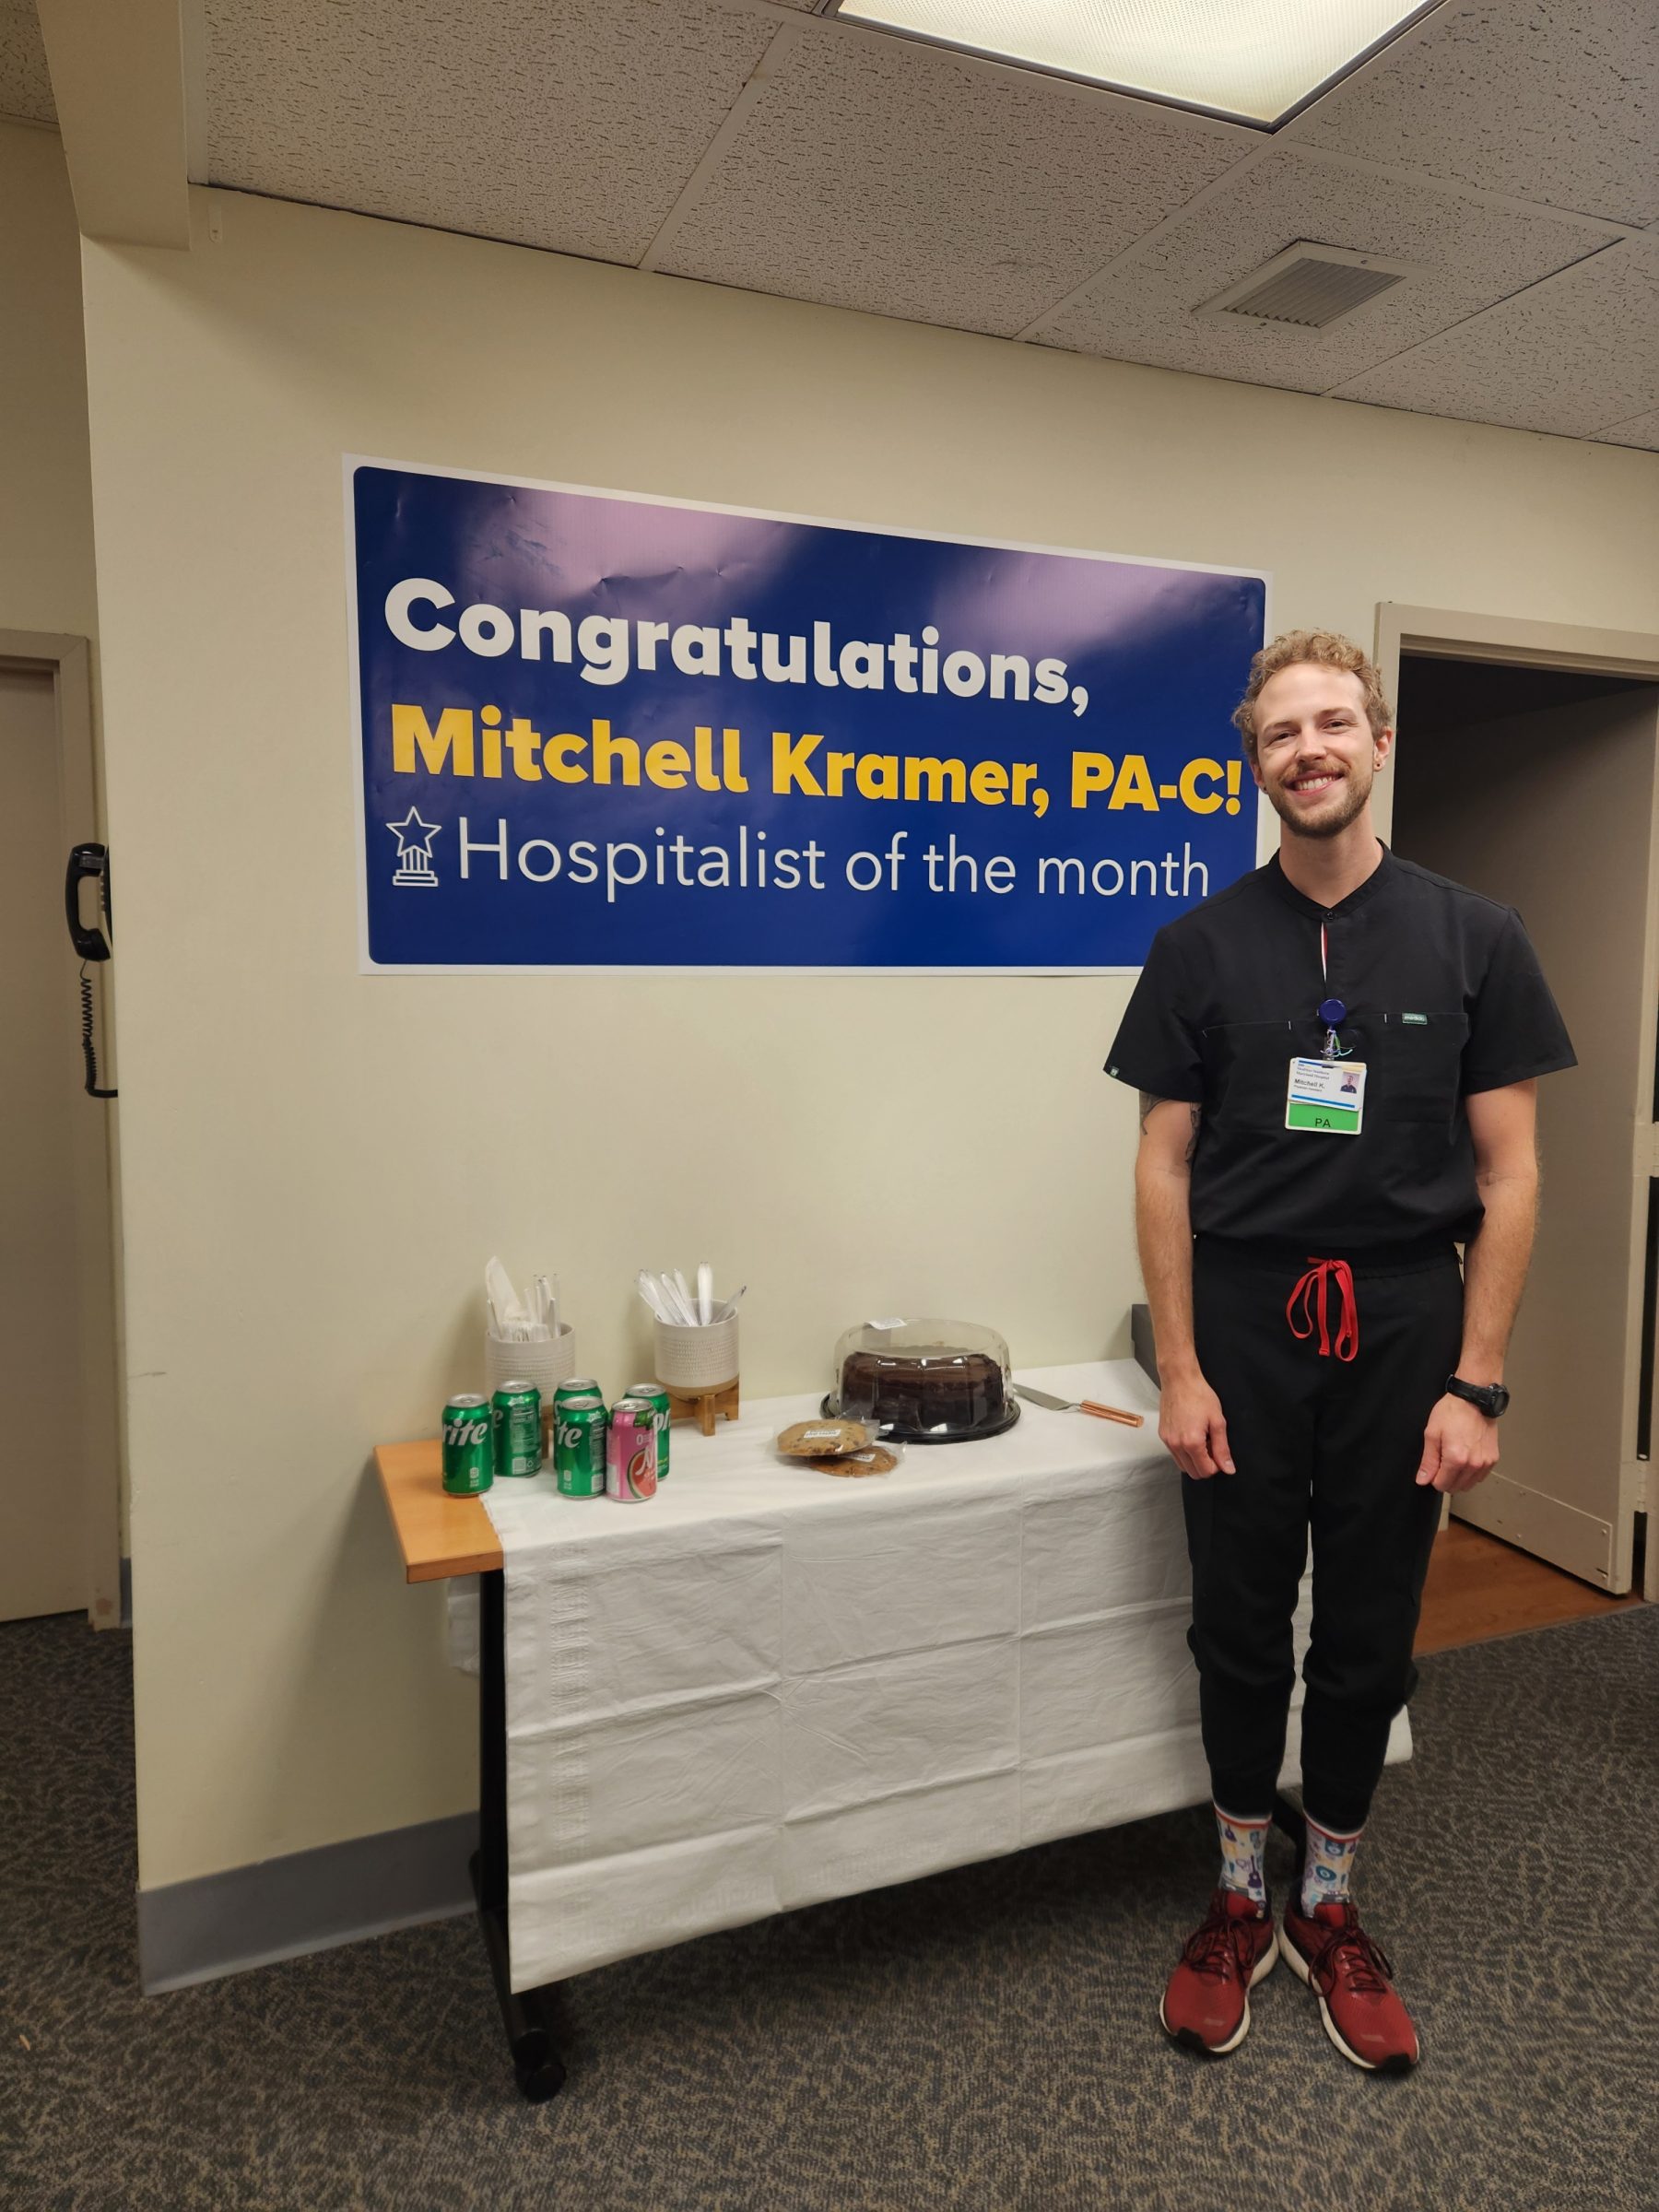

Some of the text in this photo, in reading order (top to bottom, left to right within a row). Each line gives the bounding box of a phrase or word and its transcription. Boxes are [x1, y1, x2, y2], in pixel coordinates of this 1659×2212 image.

[384, 578, 1089, 717] Congratulations,
[392, 704, 1242, 818] Mitchell Kramer, PA-C!
[459, 817, 1209, 903] Hospitalist of the month
[1294, 1078, 1318, 1088] Mitchell
[1314, 1117, 1331, 1128] PA
